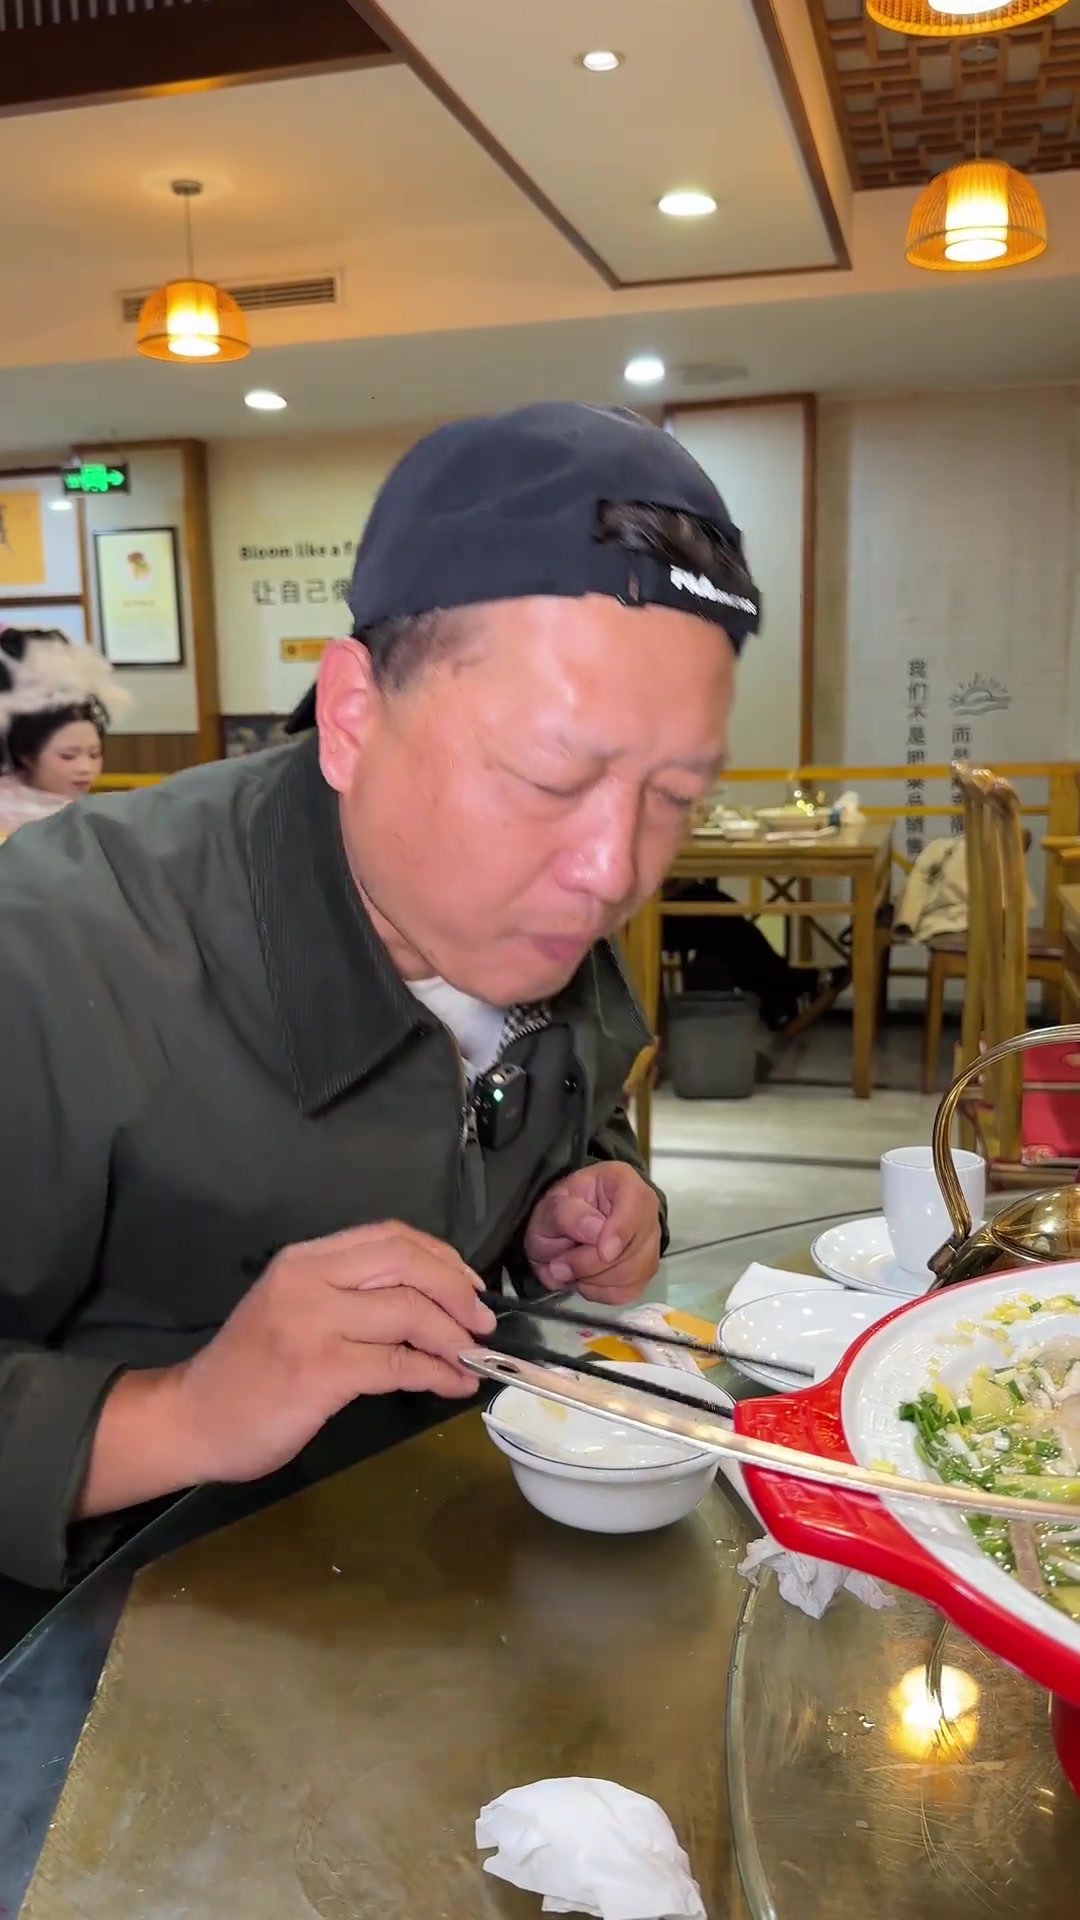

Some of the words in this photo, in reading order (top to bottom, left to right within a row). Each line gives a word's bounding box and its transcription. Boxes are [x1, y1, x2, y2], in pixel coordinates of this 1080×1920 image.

[240, 545, 292, 560] Bloom
[296, 542, 327, 558] like
[331, 546, 340, 557] a
